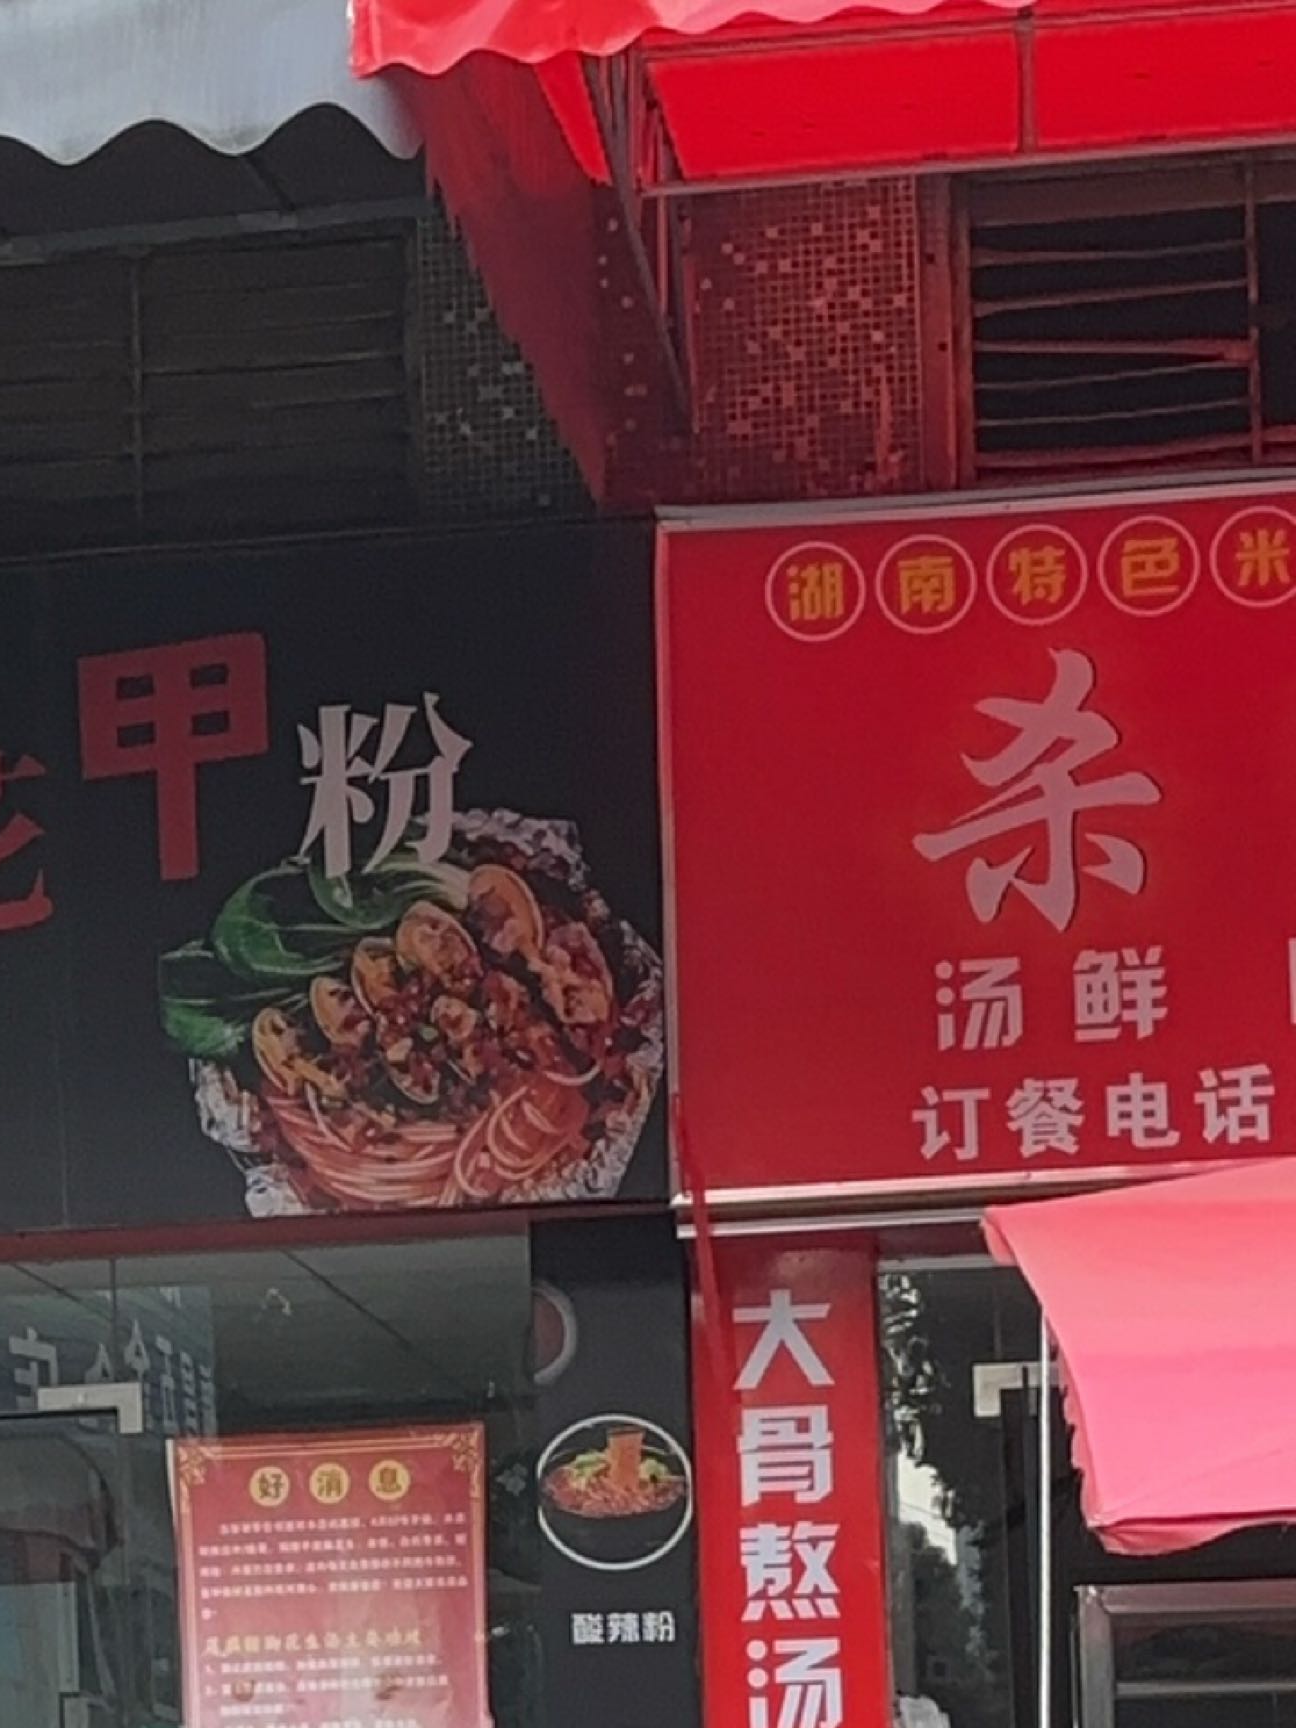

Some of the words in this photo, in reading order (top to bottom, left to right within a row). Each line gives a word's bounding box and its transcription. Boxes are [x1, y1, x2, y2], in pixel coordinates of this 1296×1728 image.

[785, 529, 1291, 620] 湖南特色米
[912, 647, 1161, 932] 杂
[934, 944, 1169, 1051] 汤鲜
[911, 1063, 1275, 1161] 订餐电话
[256, 1466, 403, 1499] 好消息
[569, 1609, 677, 1646] 酸辣粉
